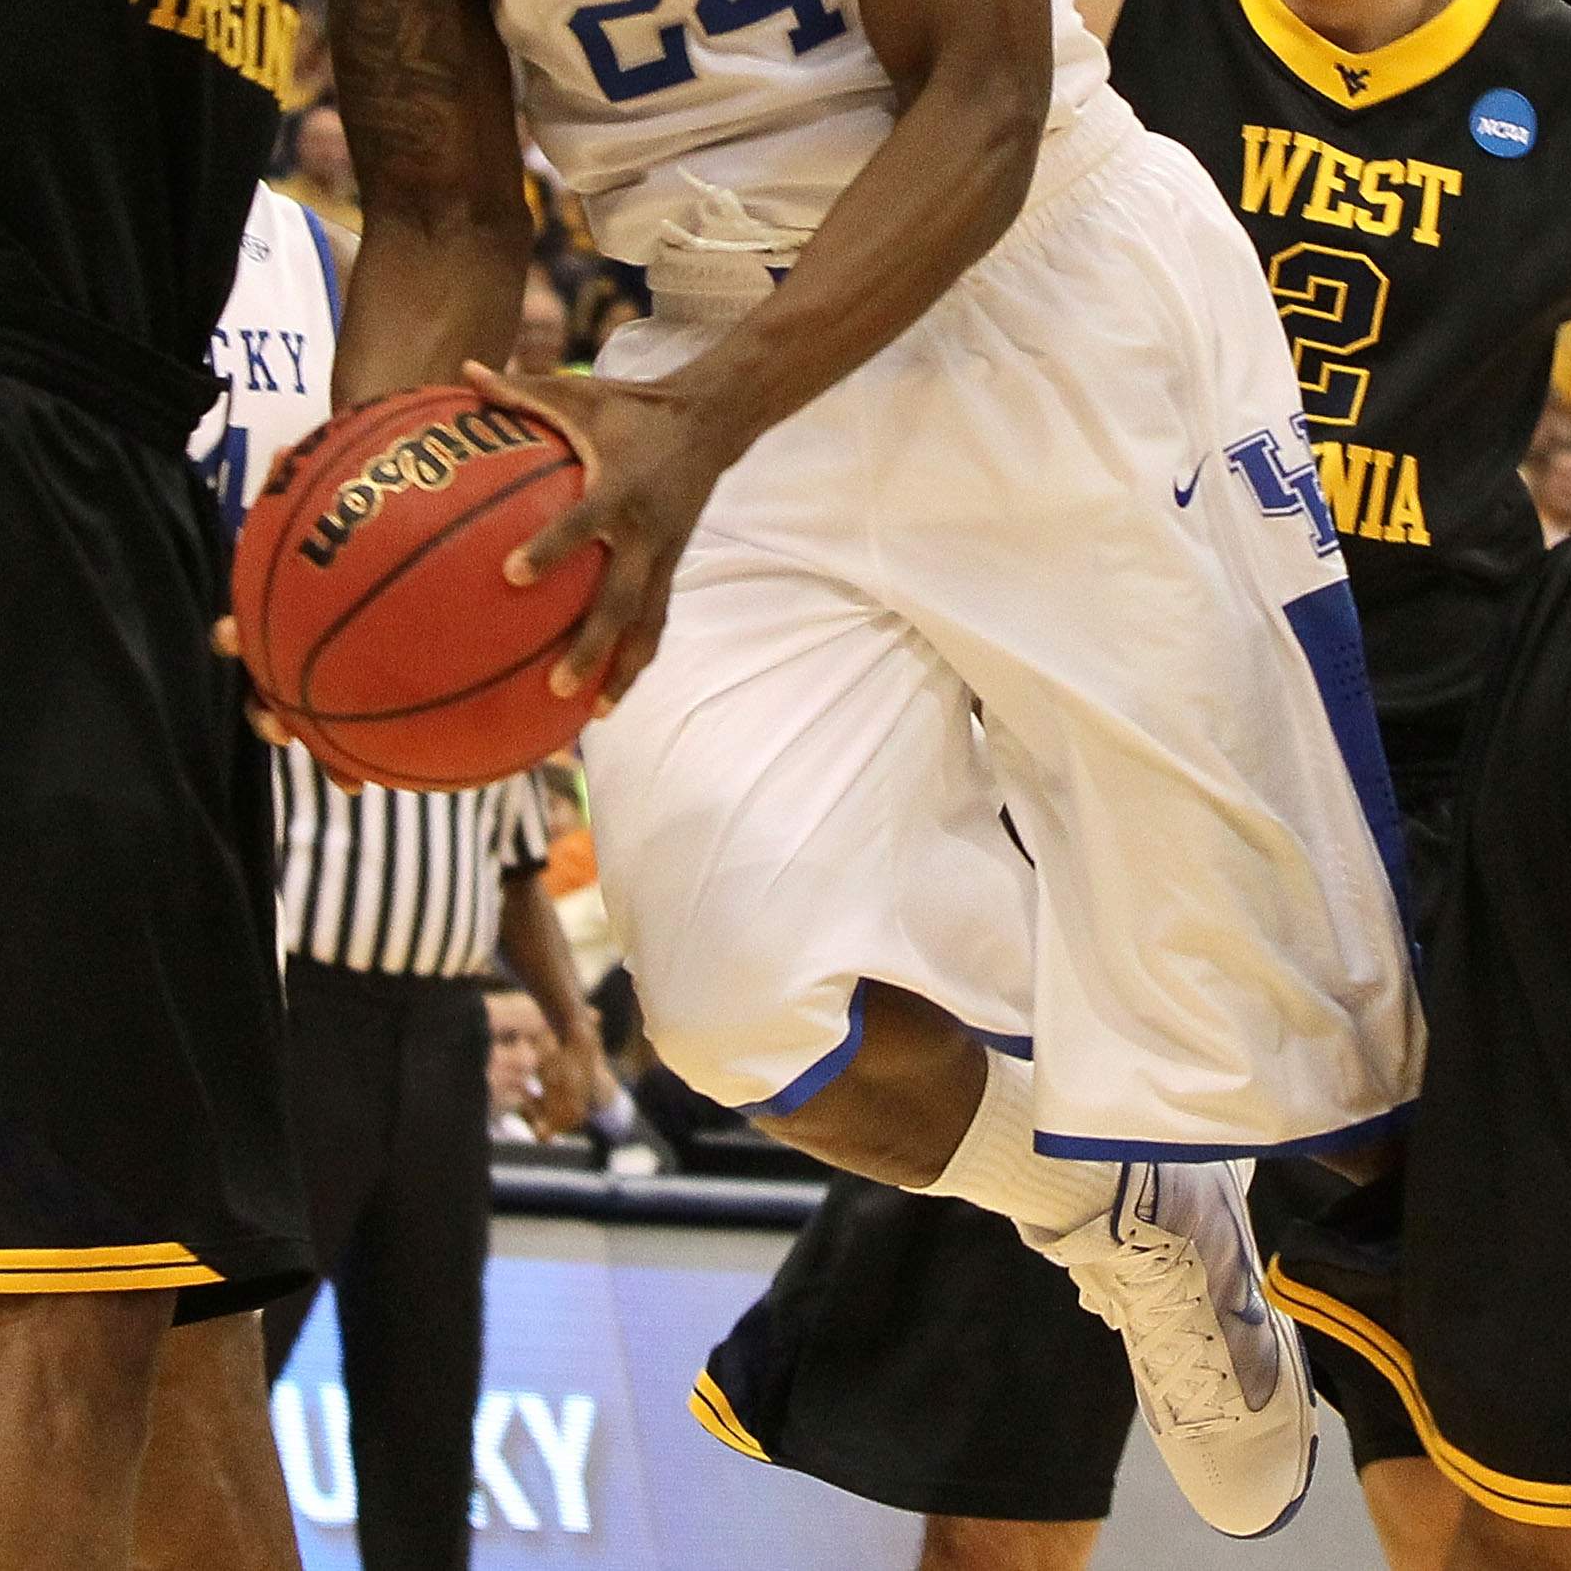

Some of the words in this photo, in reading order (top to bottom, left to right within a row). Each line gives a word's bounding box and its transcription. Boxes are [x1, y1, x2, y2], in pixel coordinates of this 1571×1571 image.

[1242, 125, 1463, 247] WEST
[1476, 116, 1531, 147] NCAA
[1268, 241, 1391, 427] 2
[299, 410, 543, 568] Wilson
